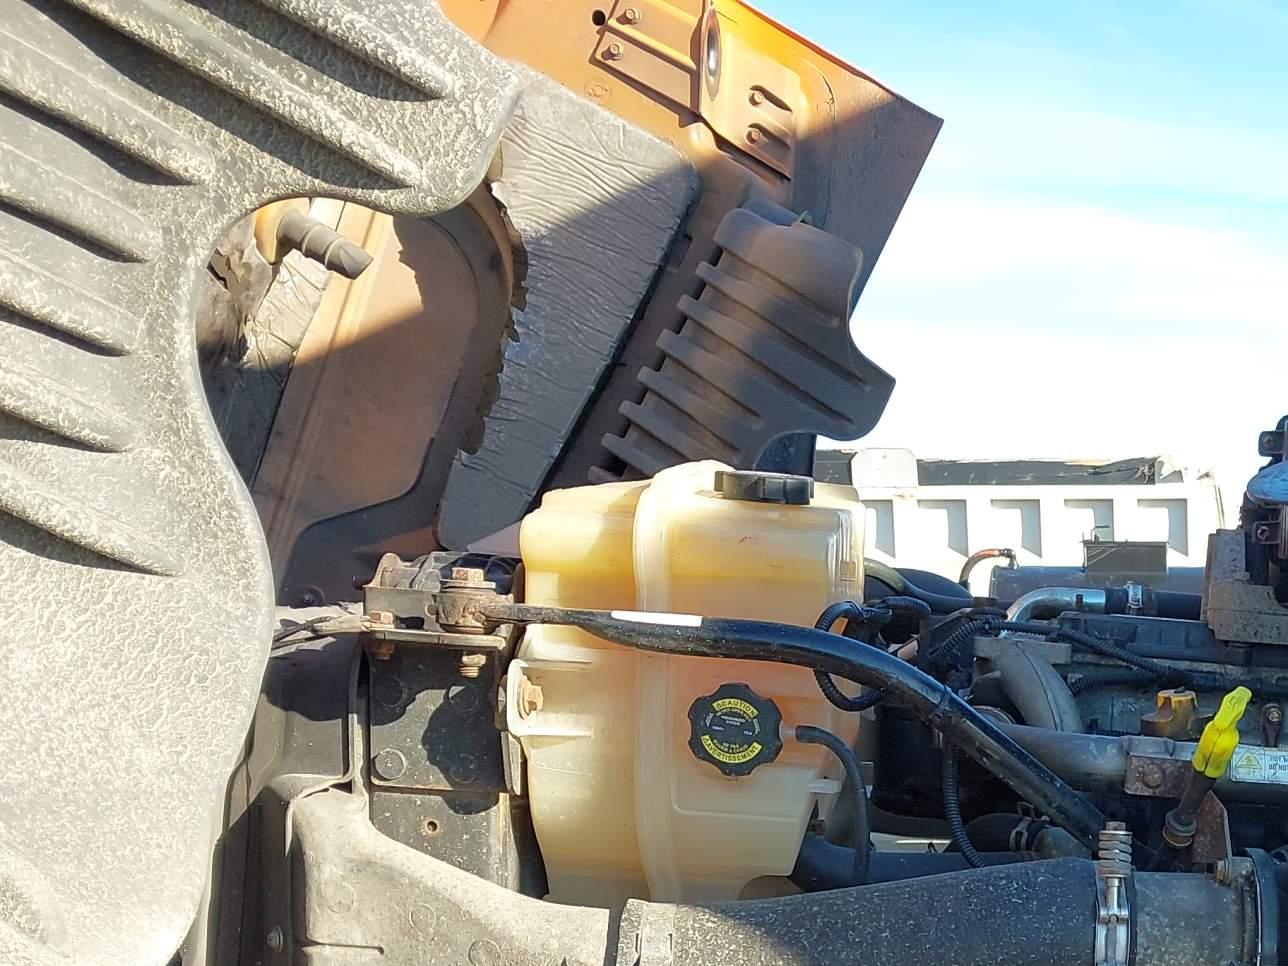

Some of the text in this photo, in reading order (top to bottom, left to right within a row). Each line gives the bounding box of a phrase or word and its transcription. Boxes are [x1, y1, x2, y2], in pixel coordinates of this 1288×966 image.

[721, 699, 757, 718] CAUTION
[704, 744, 759, 763] AVERTISSEMENT
[1268, 763, 1277, 771] DO
